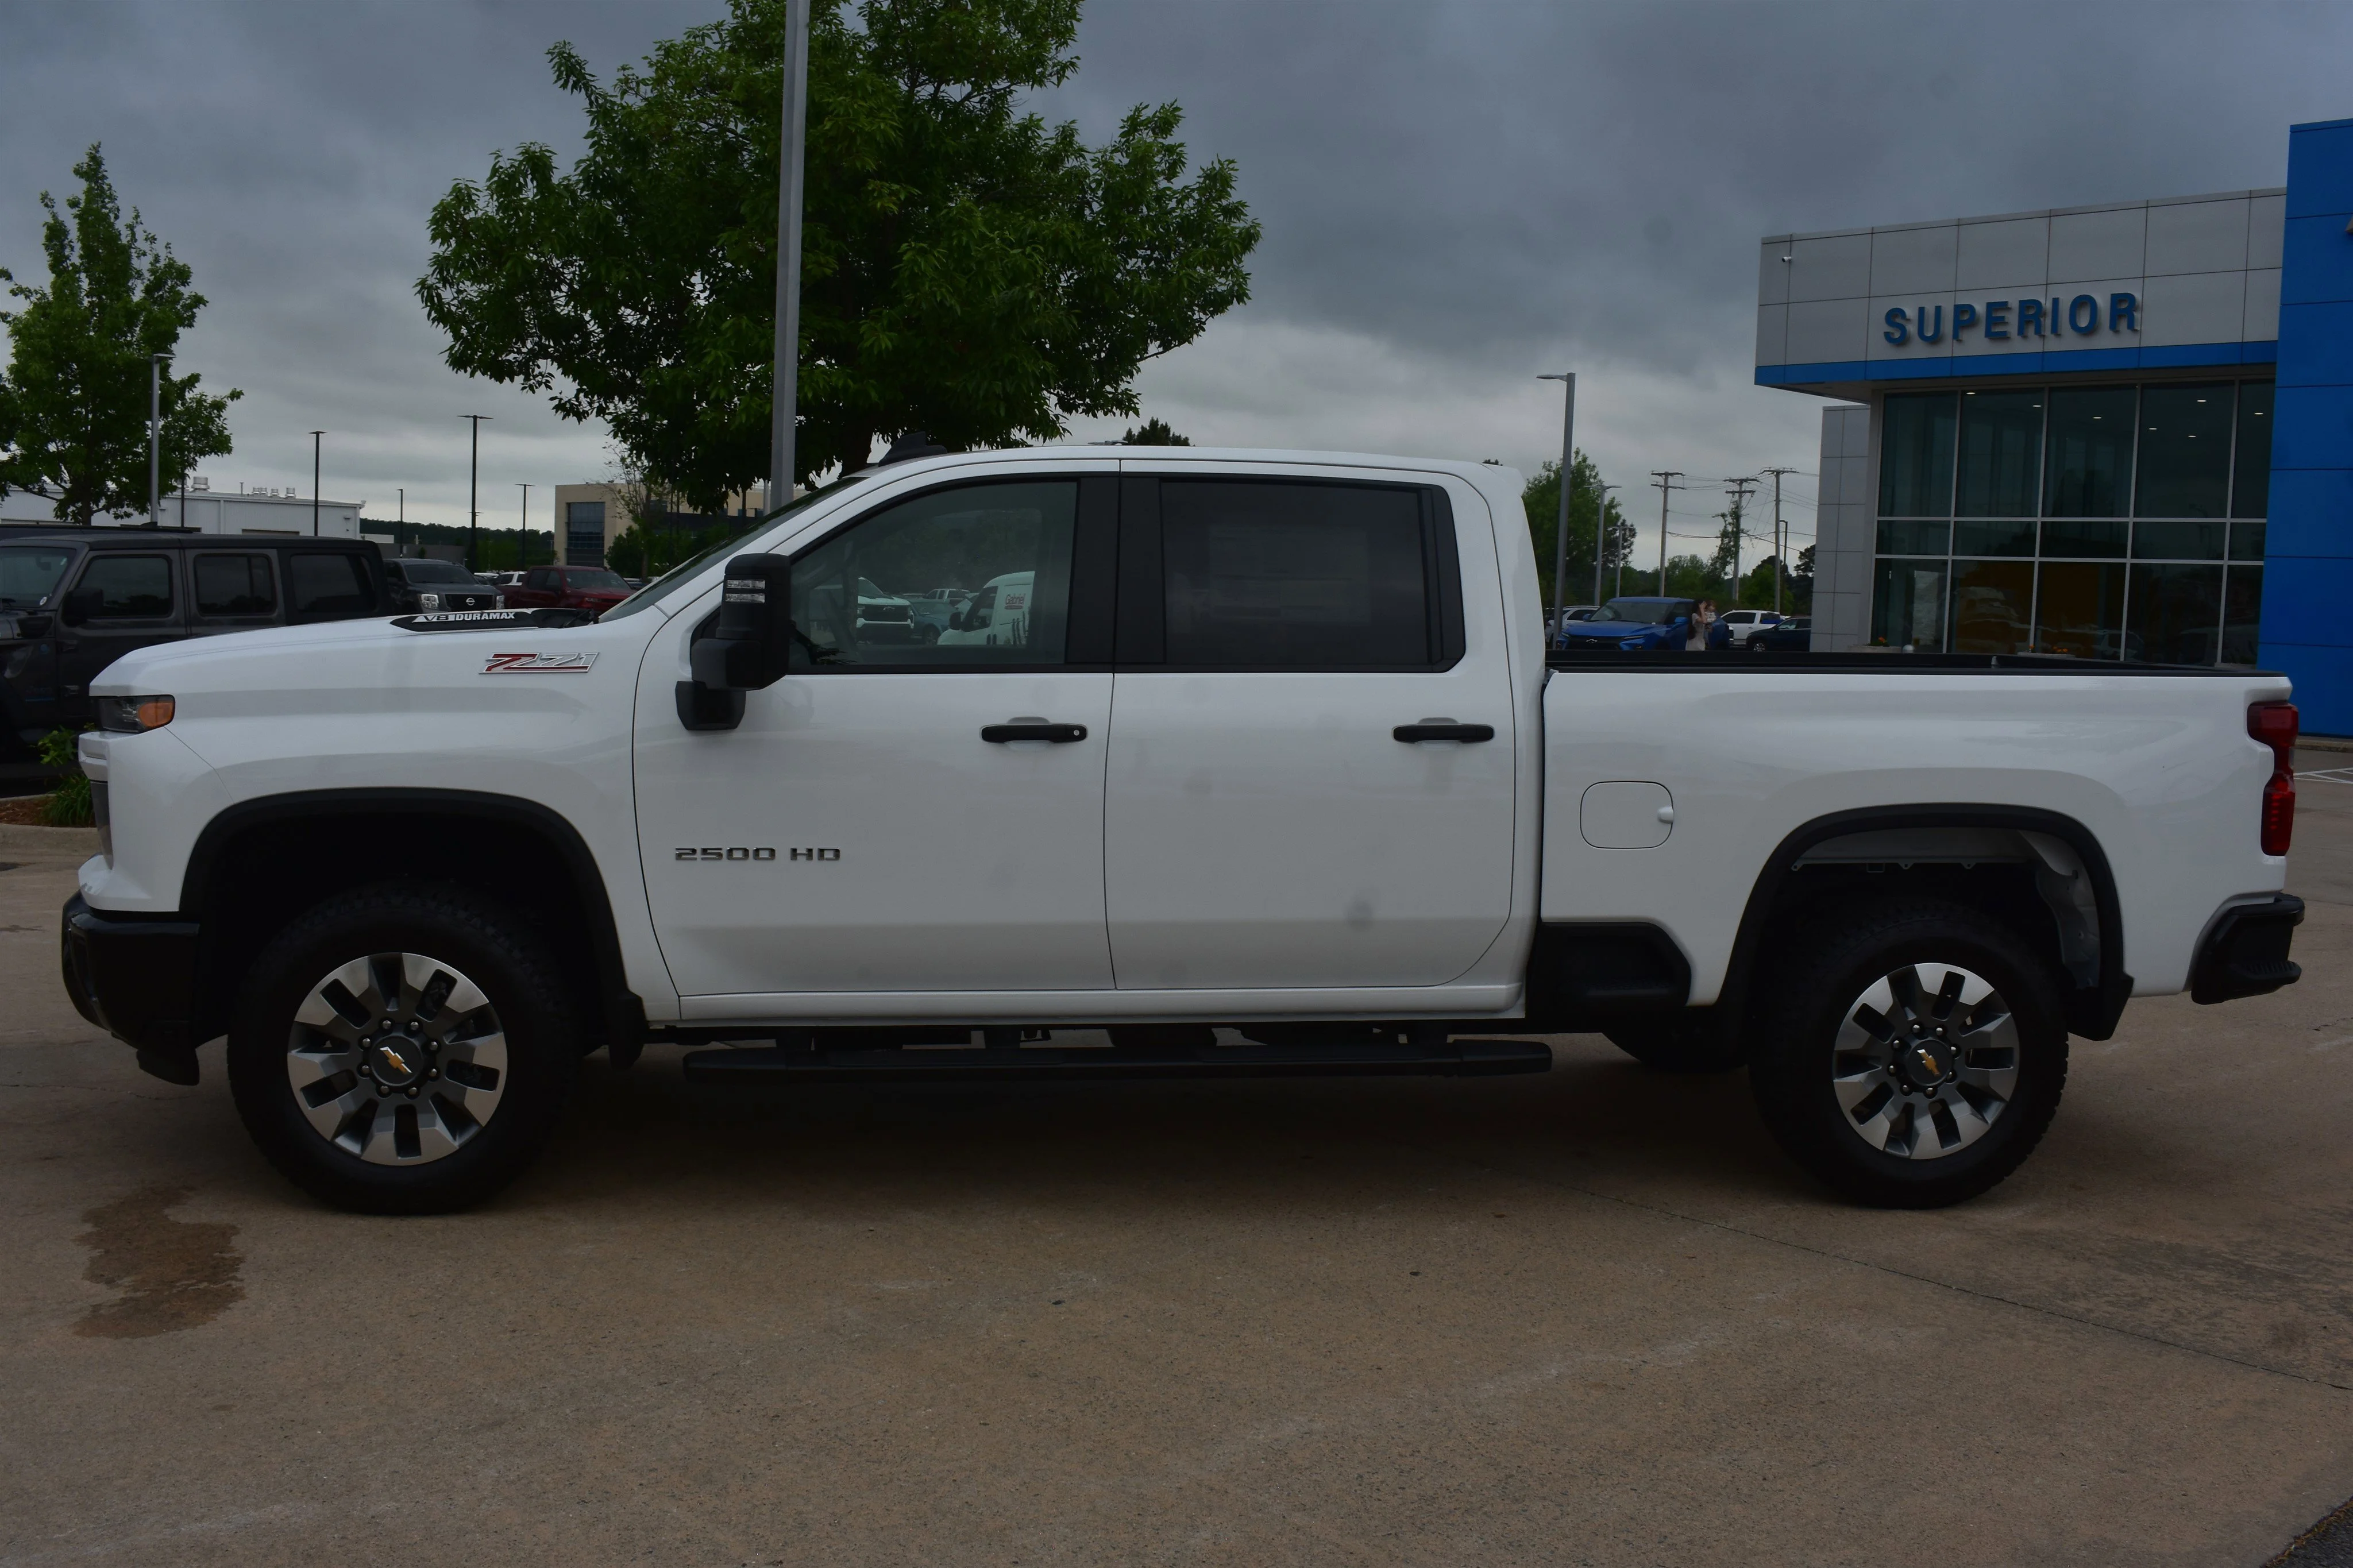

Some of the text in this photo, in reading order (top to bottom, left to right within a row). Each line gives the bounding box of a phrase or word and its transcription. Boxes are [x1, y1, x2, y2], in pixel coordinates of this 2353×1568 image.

[1883, 292, 2139, 345] SUPERIOR
[1006, 593, 1025, 604] Gabriel
[456, 612, 515, 620] DURAMAX
[479, 652, 600, 675] Z71
[675, 847, 840, 861] 2500 HD
